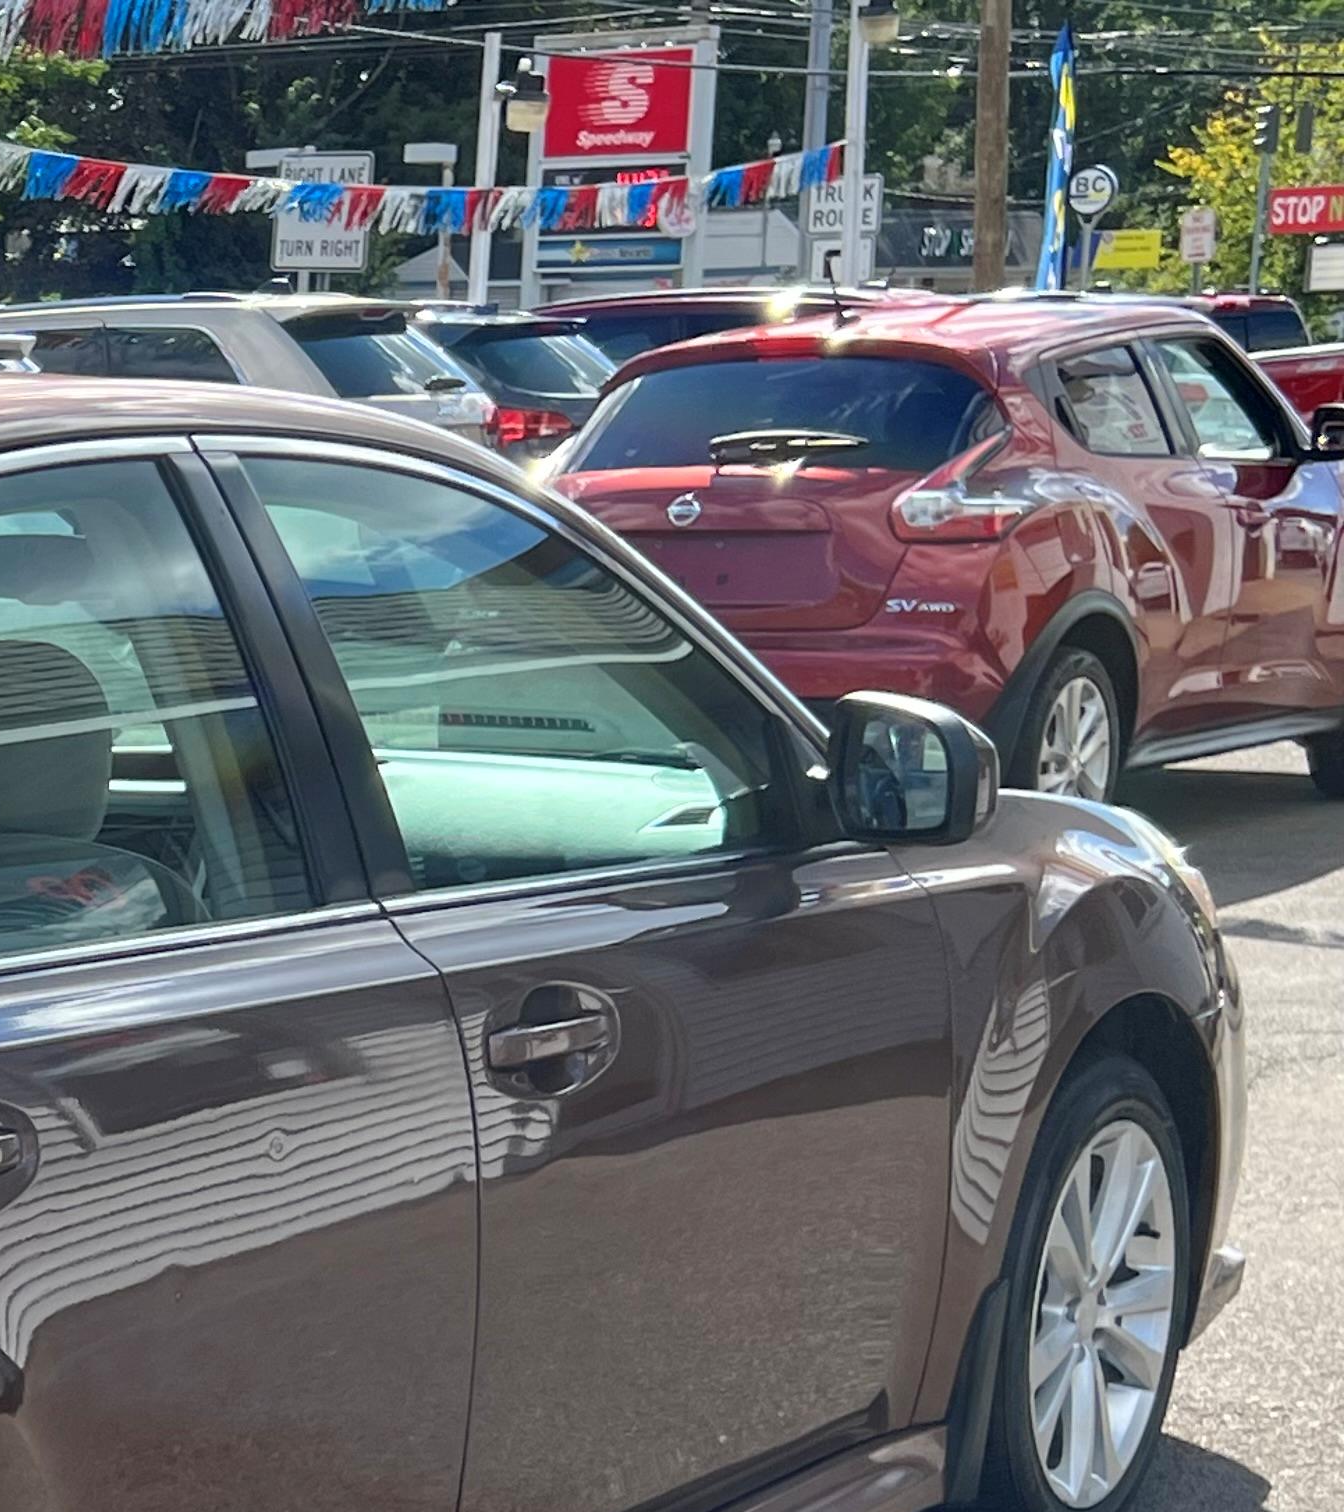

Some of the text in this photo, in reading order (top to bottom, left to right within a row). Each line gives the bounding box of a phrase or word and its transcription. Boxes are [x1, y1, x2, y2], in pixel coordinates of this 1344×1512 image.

[576, 130, 656, 150] Speedway
[330, 166, 365, 184] LANE
[1272, 194, 1326, 225] STOP
[279, 240, 360, 257] TURN RIGHT
[885, 599, 955, 613] SV AWD
